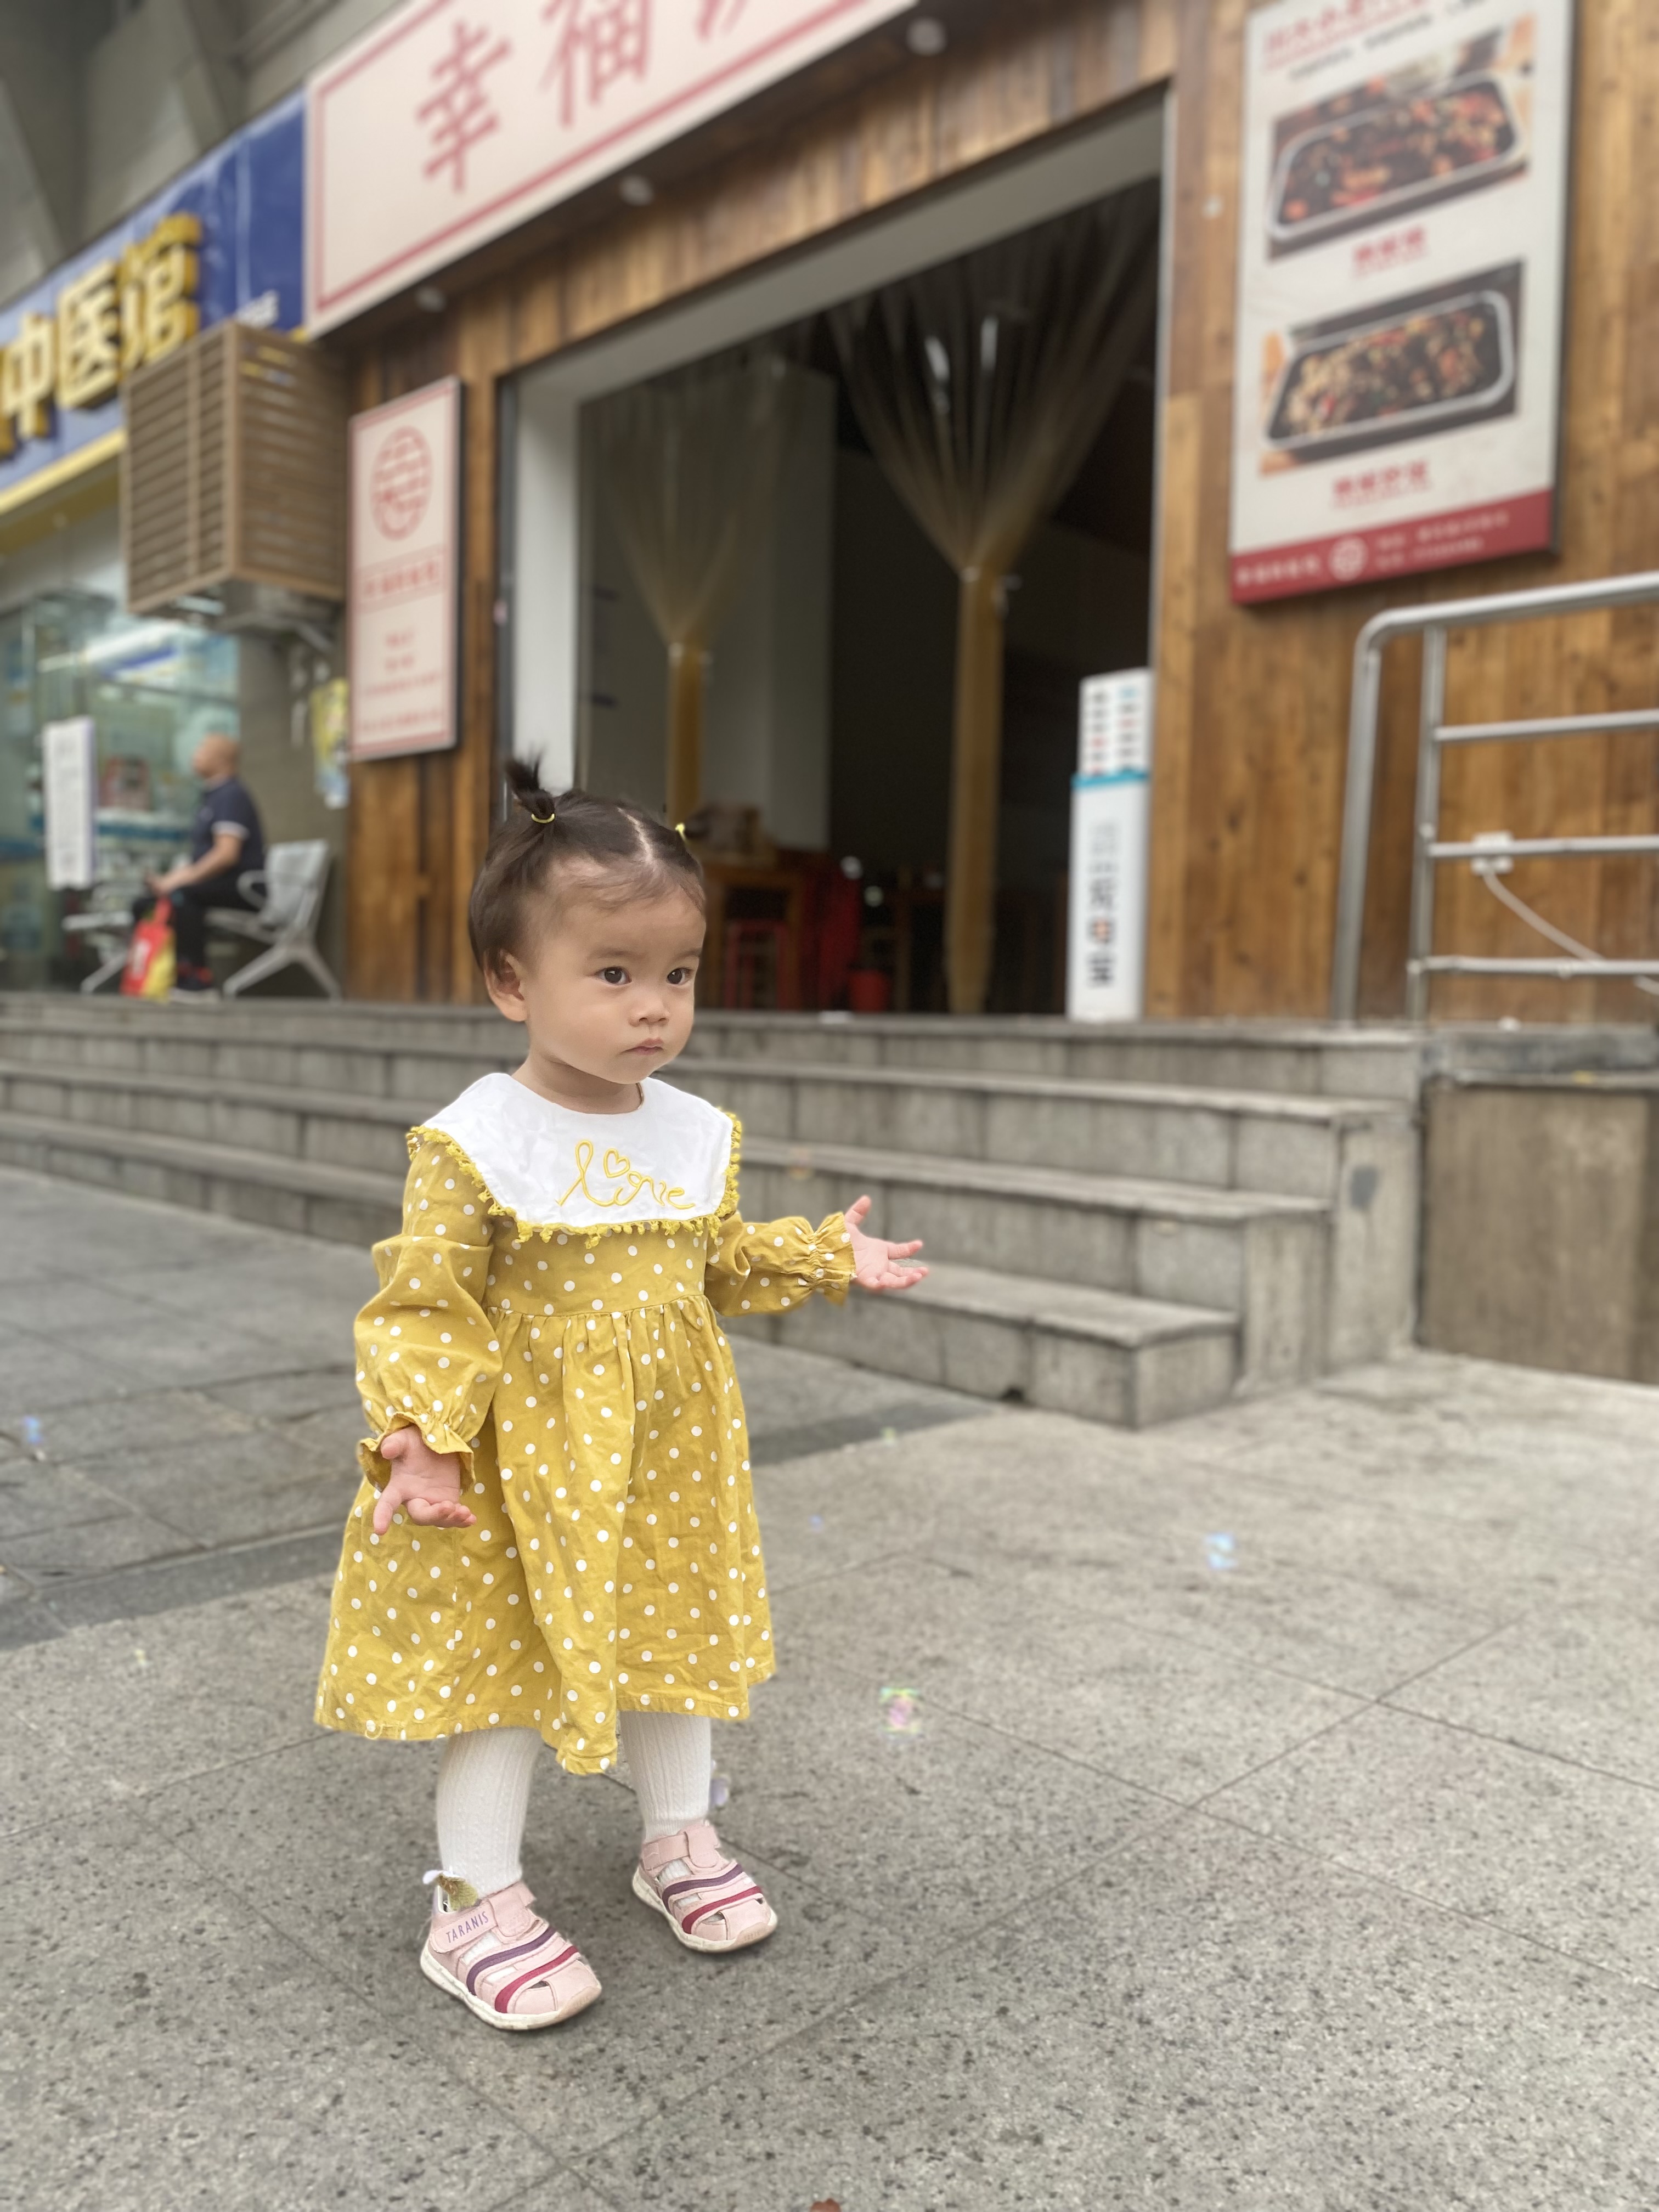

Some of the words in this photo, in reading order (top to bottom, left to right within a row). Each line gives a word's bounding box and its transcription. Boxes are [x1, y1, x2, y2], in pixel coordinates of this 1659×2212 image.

[415, 0, 747, 192] 幸福
[1, 212, 201, 438] 中医馆
[445, 1911, 488, 1943] TARANIS
